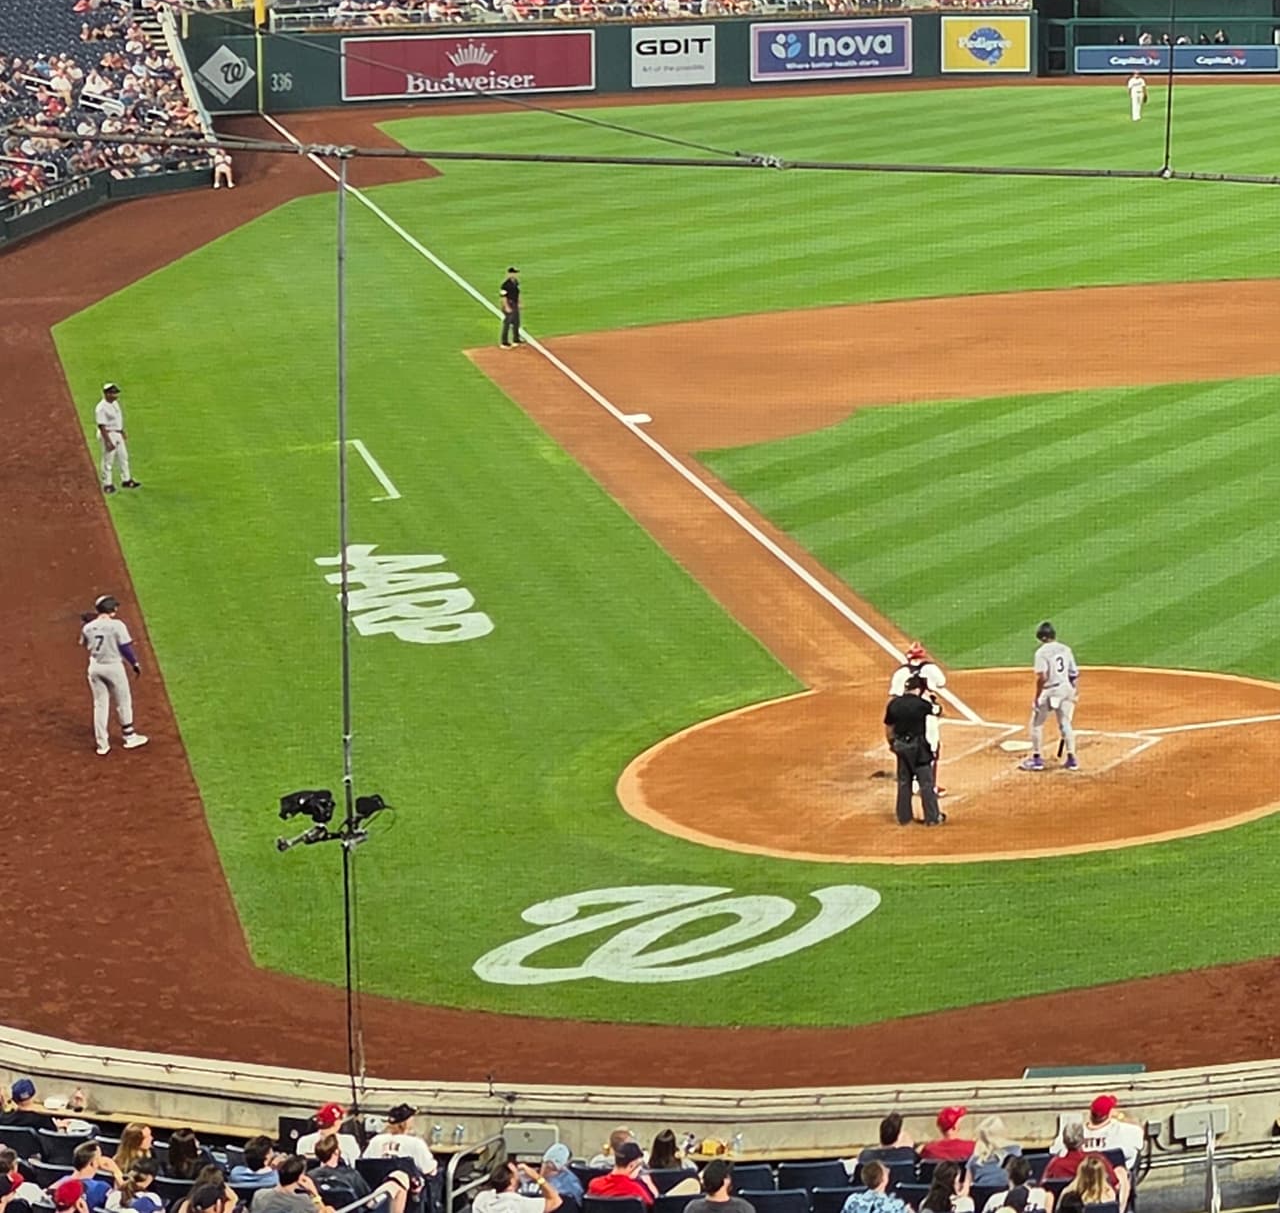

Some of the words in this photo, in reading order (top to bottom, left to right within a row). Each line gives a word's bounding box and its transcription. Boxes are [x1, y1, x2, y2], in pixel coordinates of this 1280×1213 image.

[636, 38, 711, 55] GDIT
[809, 32, 892, 57] Inova
[959, 35, 1012, 52] Pedigree
[407, 69, 535, 94] Budweiser
[316, 544, 494, 644] AARP
[94, 636, 104, 652] 7
[1055, 656, 1064, 673] 3
[472, 884, 881, 985] W
